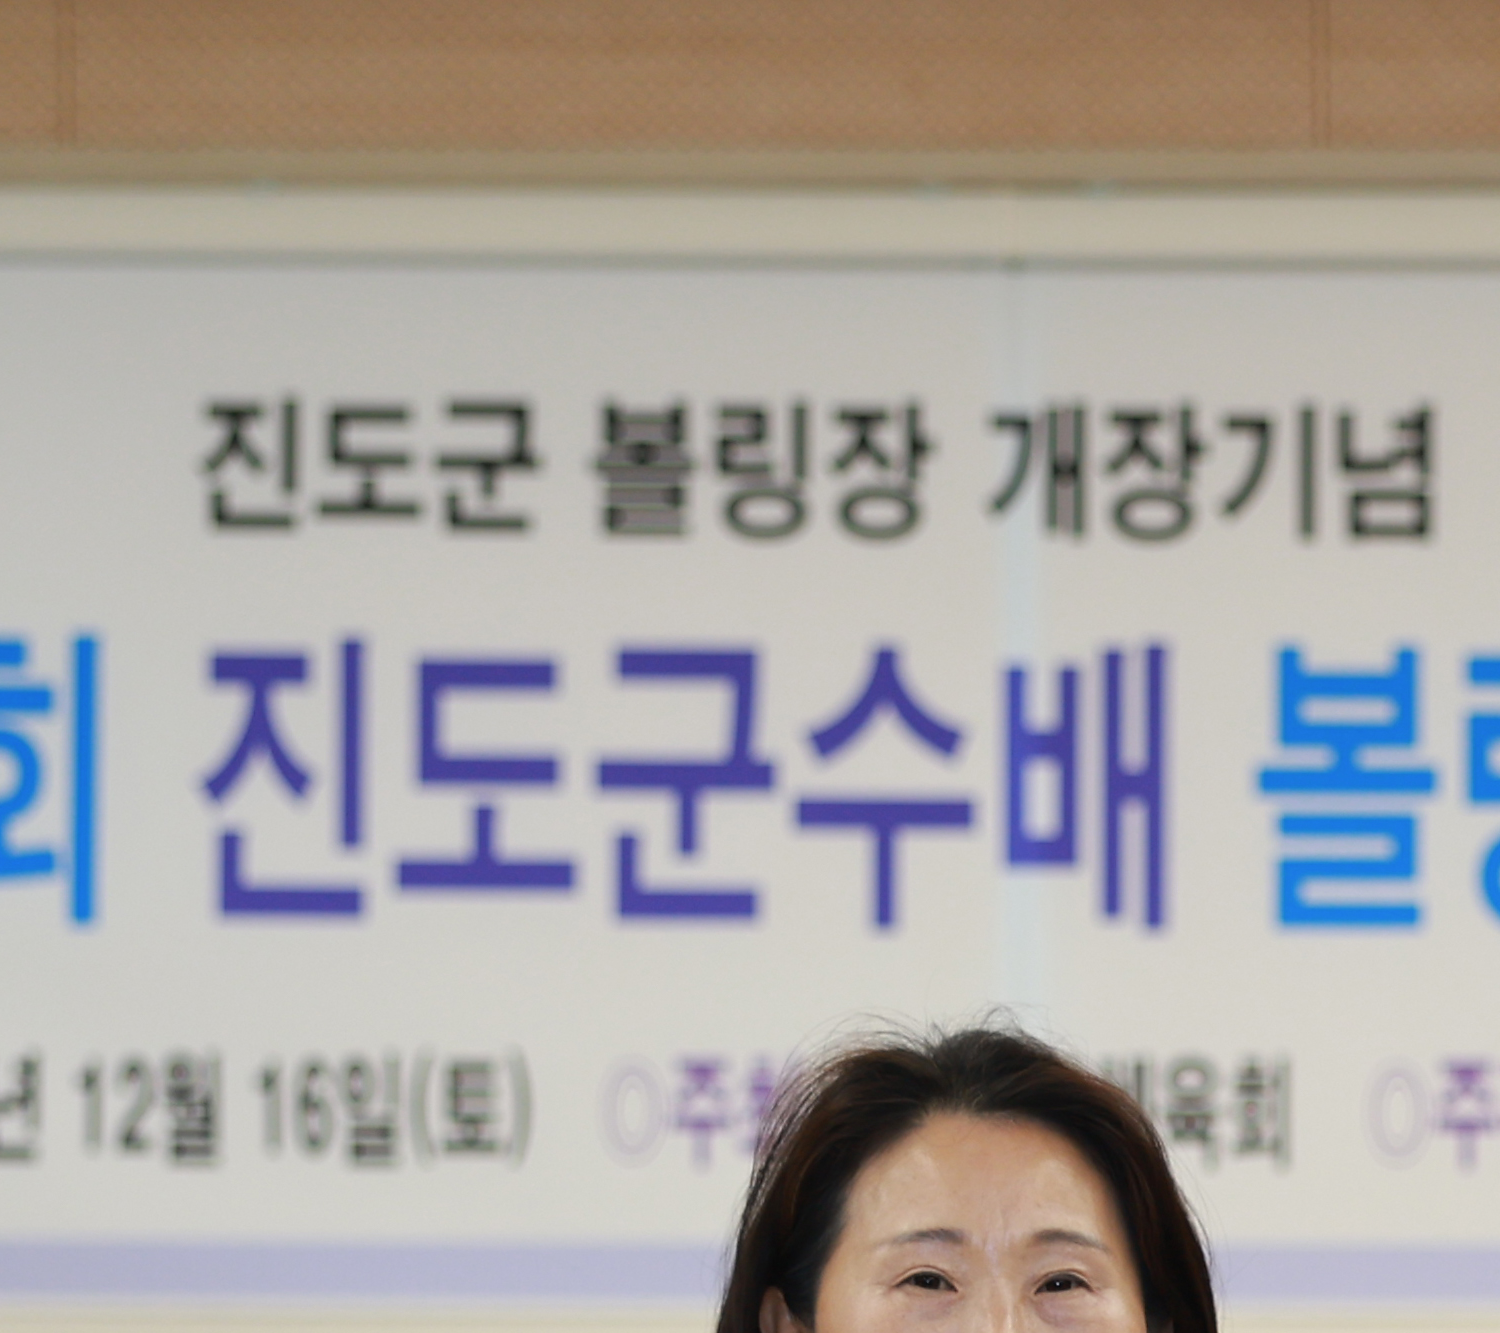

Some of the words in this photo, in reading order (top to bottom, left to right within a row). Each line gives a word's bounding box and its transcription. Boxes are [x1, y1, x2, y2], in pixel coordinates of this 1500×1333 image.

[200, 395, 542, 534] 진도군
[592, 400, 934, 542] 볼링장
[988, 402, 1436, 543] 개장기념
[199, 633, 1171, 933] 진도군수배
[79, 1054, 221, 1167] 12월
[257, 1056, 533, 1168] 16일(토)
